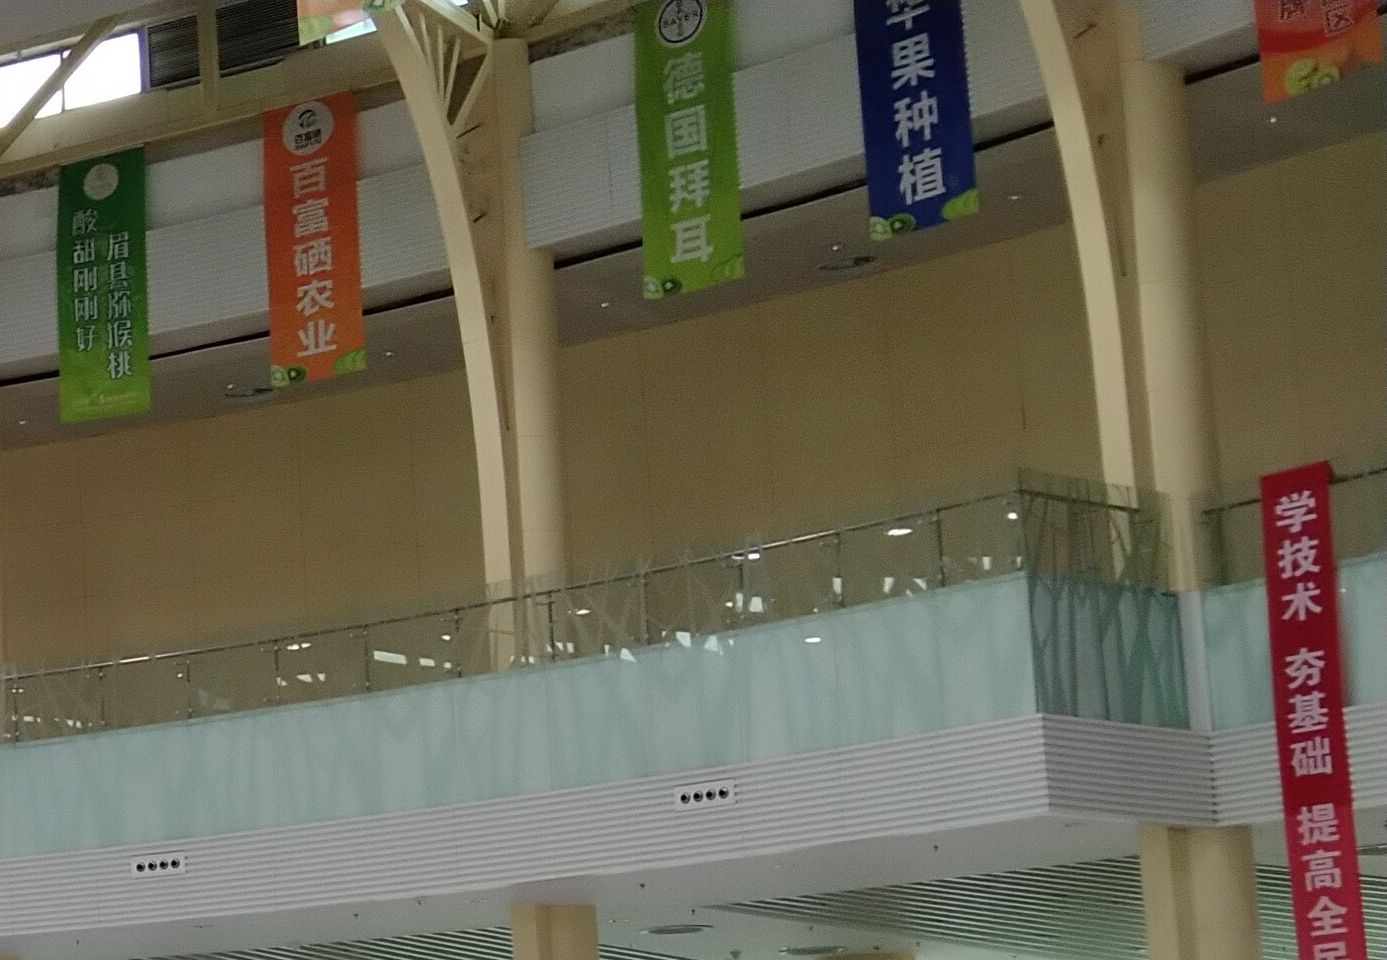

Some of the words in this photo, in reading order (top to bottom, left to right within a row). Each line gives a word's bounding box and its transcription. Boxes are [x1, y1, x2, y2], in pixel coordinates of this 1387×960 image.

[662, 50, 713, 265] 德国拜耳
[72, 209, 98, 352] 酸甜刚刚好
[106, 231, 132, 379] 眉县猕猴桃
[290, 155, 338, 358] 百富硒农业
[1275, 490, 1322, 621] 学技术
[1284, 647, 1334, 777] 夯基础
